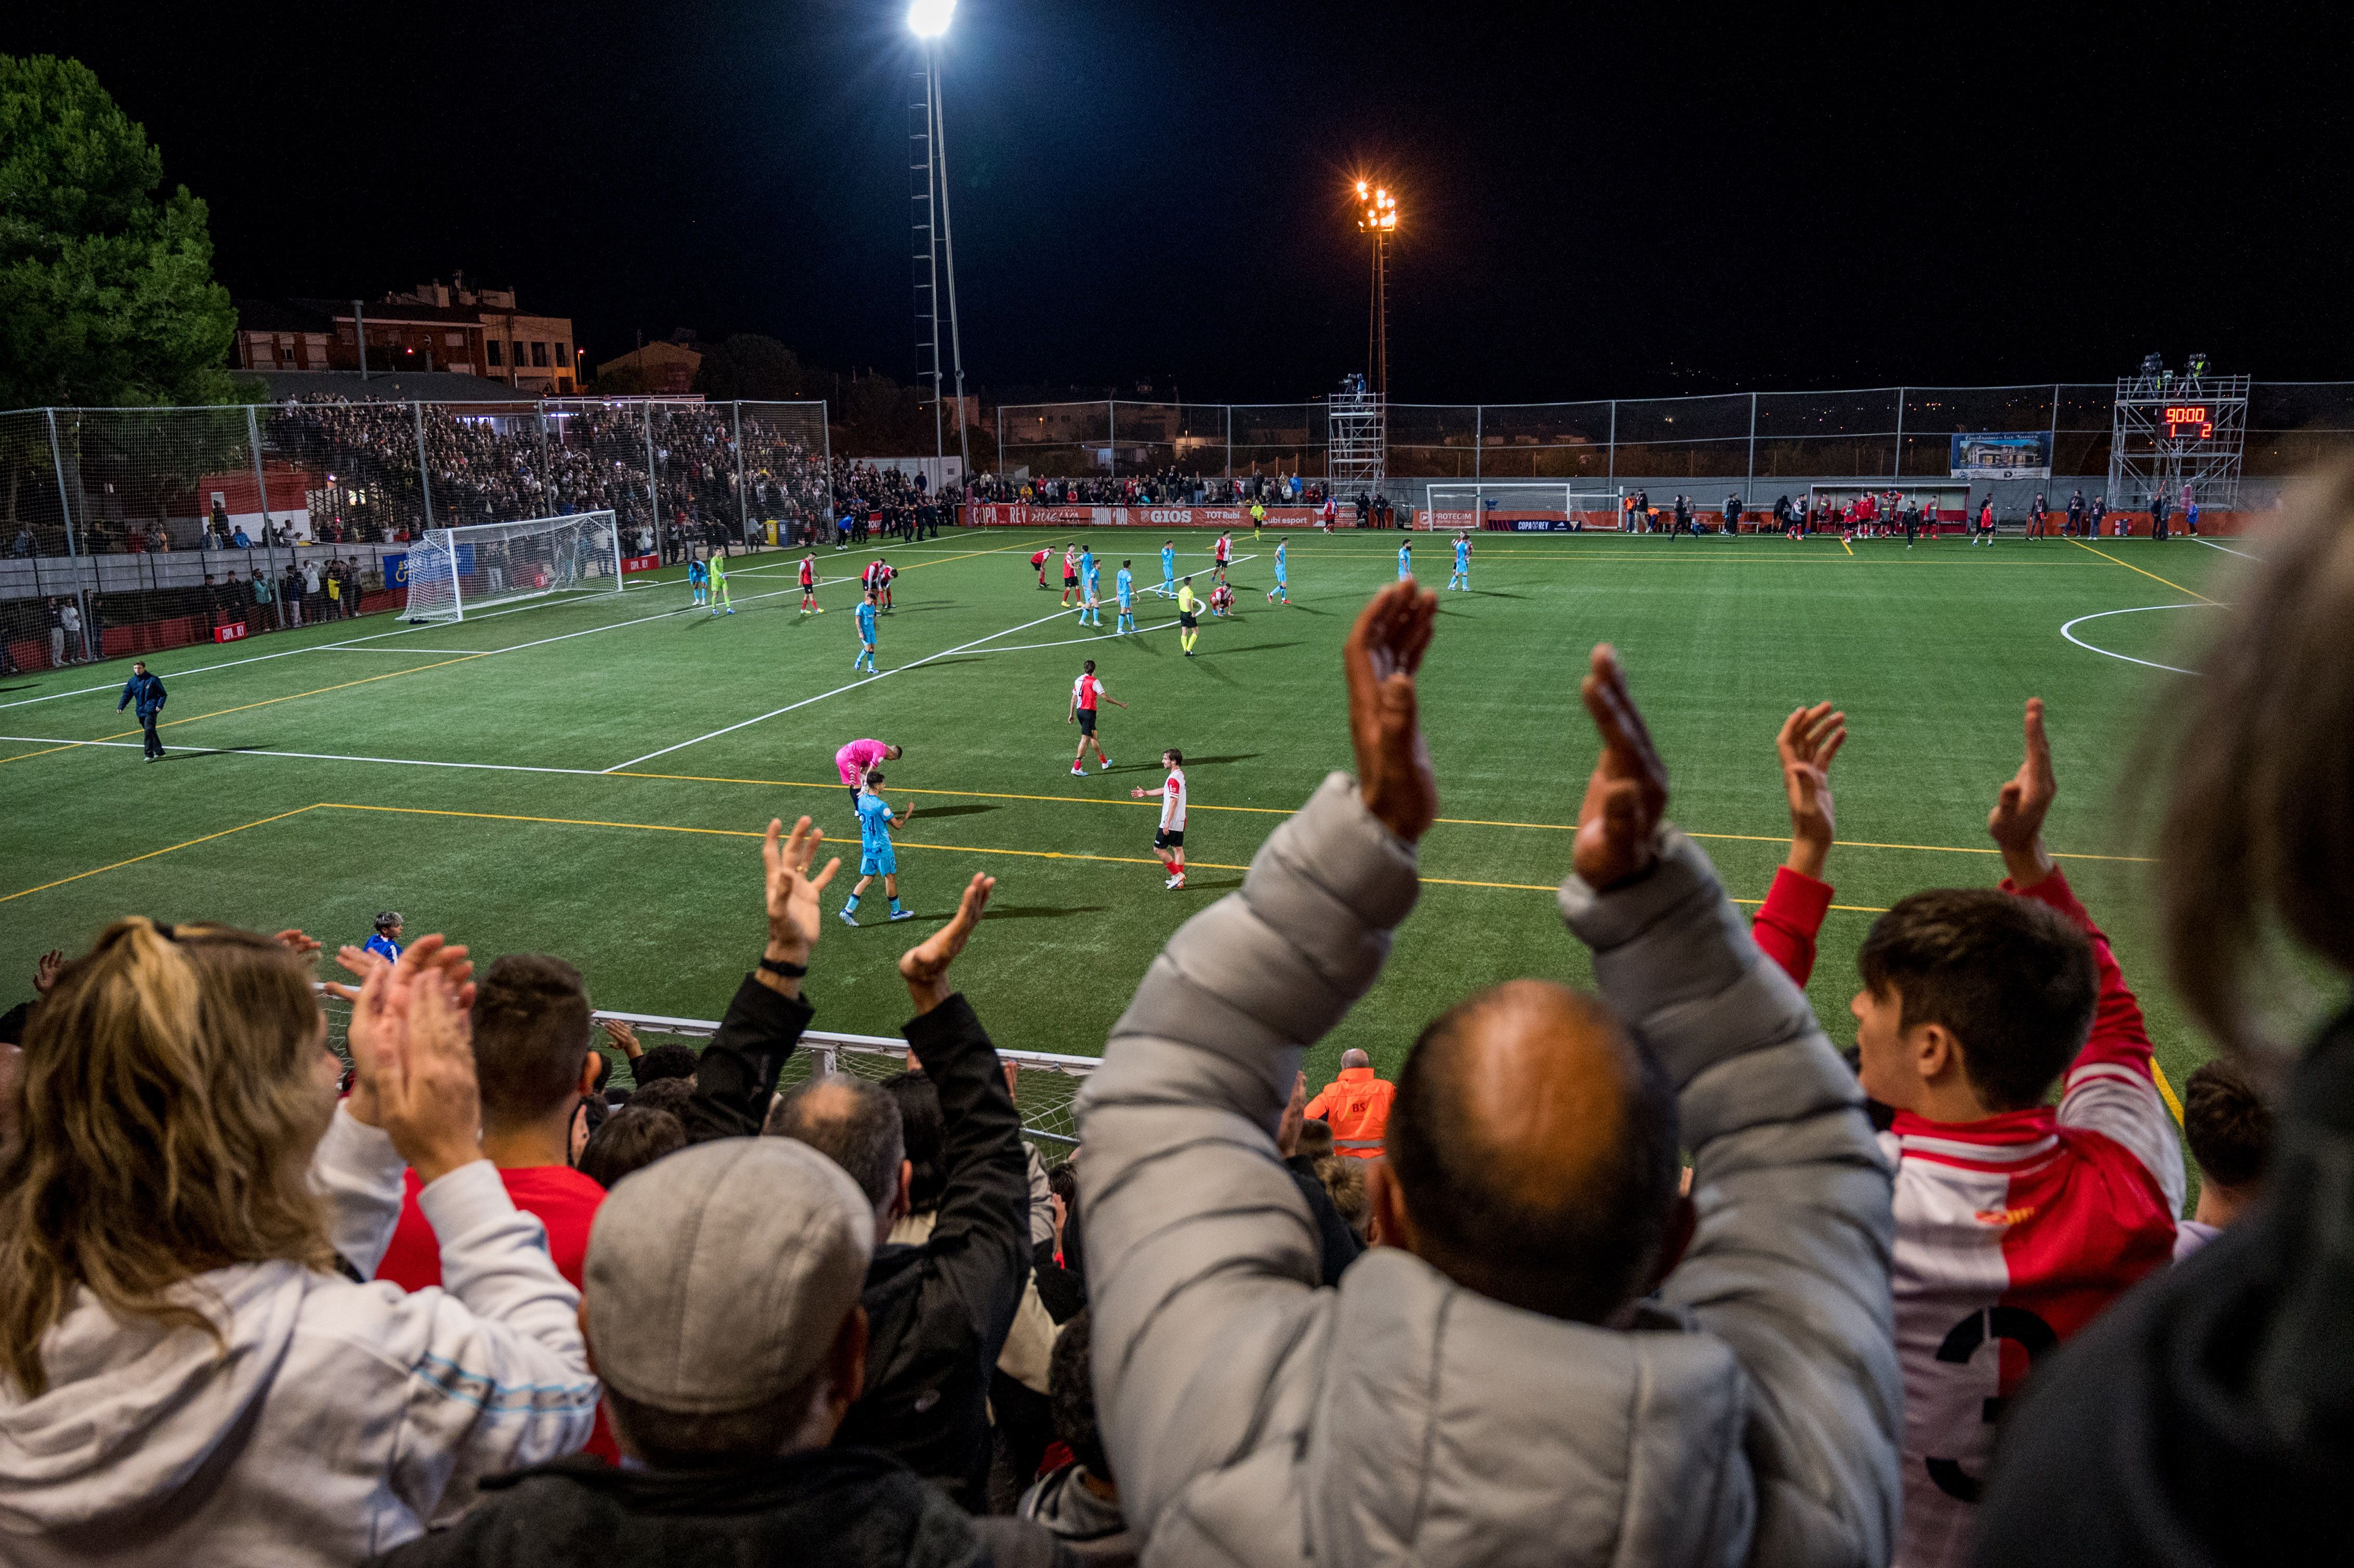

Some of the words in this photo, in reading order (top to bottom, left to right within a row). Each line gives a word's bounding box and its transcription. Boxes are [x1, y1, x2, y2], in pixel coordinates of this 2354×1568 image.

[2166, 409, 2205, 423] 90:00
[2171, 424, 2176, 438] 1
[2201, 424, 2212, 437] 2
[973, 507, 997, 524] COPA
[1010, 506, 1026, 523] REY
[1092, 507, 1111, 525] ROBIN
[1150, 510, 1192, 523] GIOS
[1518, 521, 1532, 530] COPA
[1538, 521, 1549, 530] REY
[223, 628, 233, 640] COPA
[1352, 1103, 1366, 1113] BS
